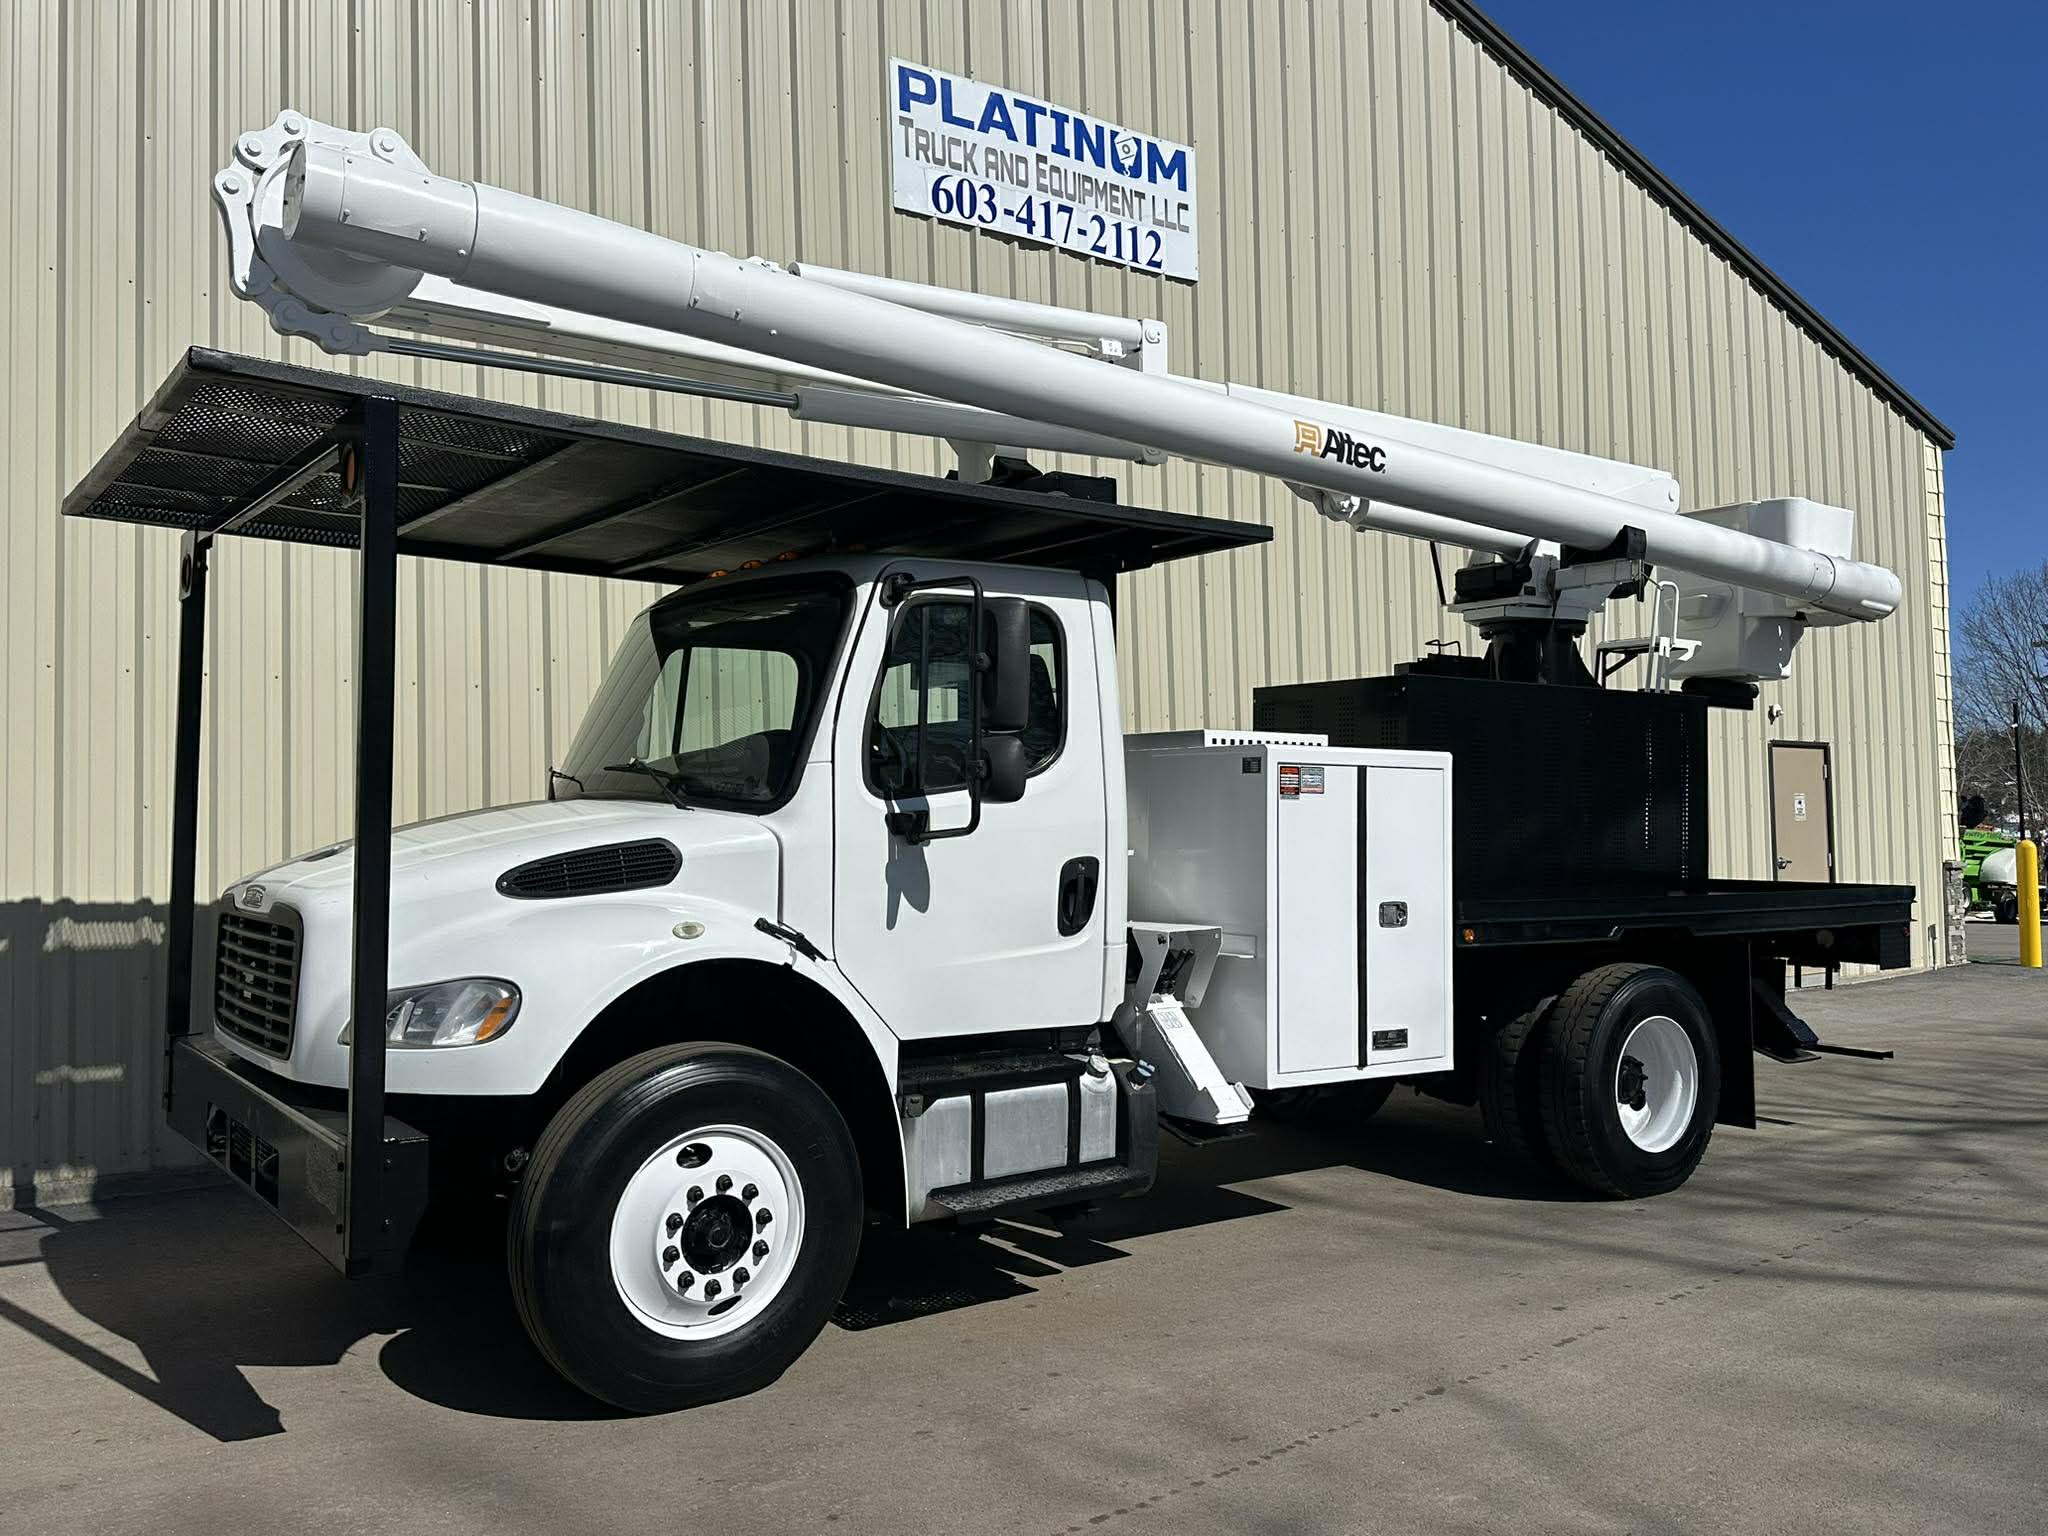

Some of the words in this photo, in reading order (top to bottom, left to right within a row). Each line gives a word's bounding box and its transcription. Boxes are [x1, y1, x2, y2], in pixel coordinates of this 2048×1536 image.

[898, 65, 1187, 191] PLATINUM
[899, 116, 977, 174] TRUCK
[984, 147, 1029, 188] AND
[1036, 153, 1145, 221] EQUIPMENT
[1152, 194, 1190, 232] LLC
[932, 174, 1163, 268] 603-417-2112
[1320, 429, 1386, 472] Altec
